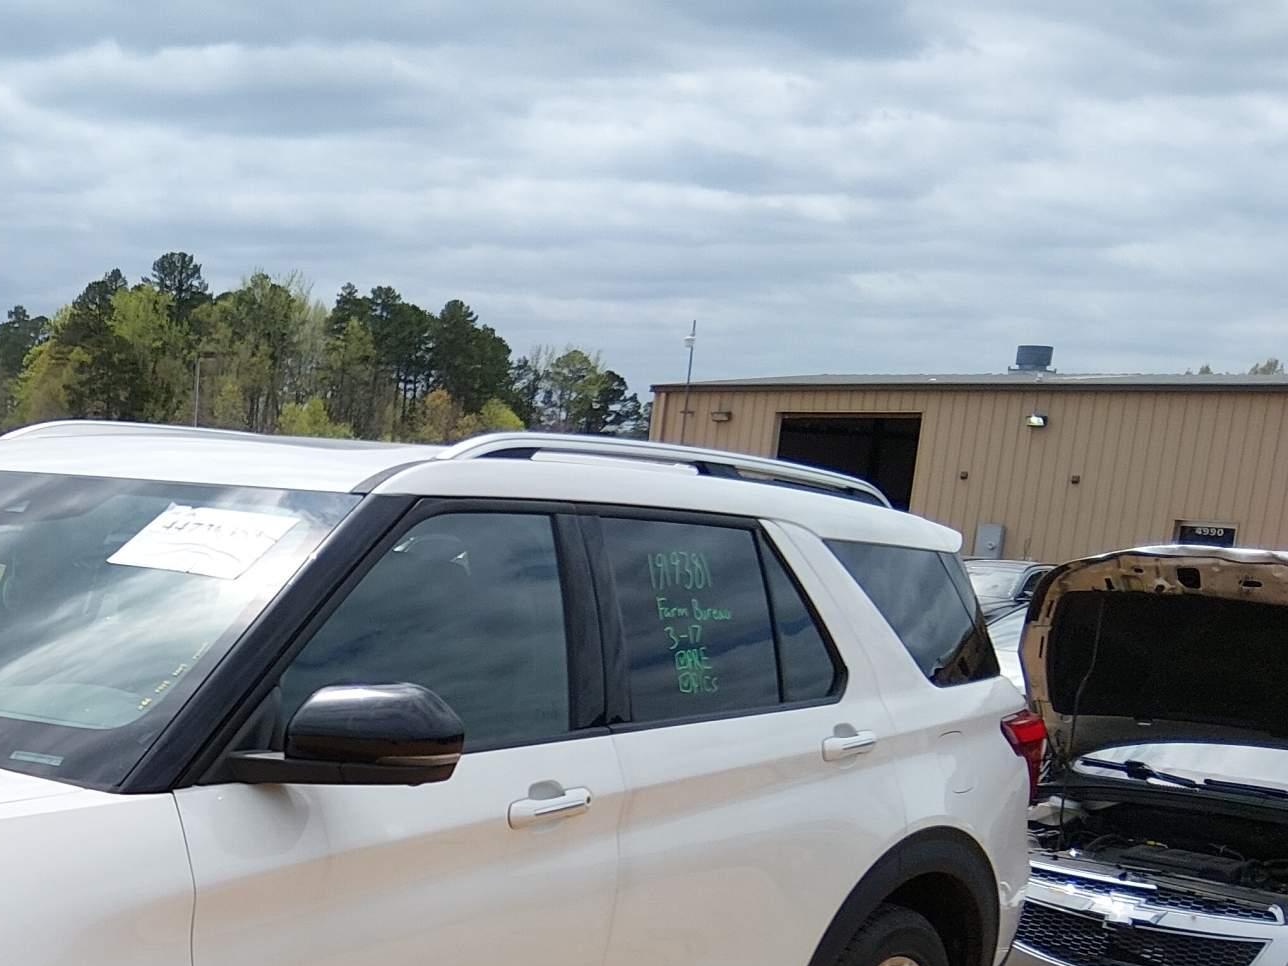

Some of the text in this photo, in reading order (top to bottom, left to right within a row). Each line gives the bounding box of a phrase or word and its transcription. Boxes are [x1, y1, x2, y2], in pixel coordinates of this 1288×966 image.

[1195, 527, 1224, 537] 4990
[656, 597, 688, 620] Farm
[664, 624, 702, 650] 3-17
